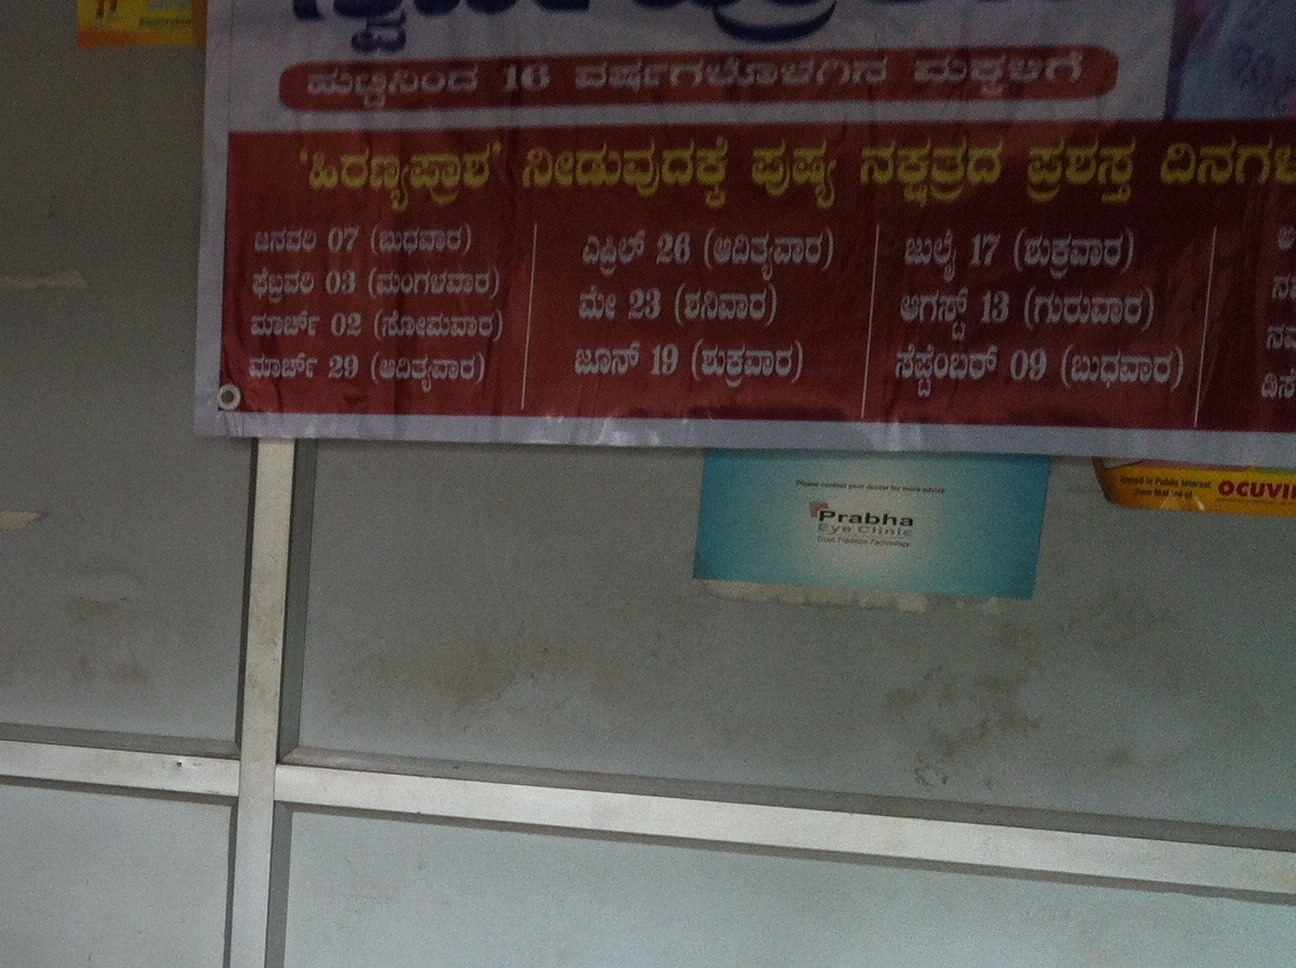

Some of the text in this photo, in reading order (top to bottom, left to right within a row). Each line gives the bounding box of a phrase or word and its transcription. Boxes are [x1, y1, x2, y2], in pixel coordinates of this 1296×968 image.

[502, 63, 552, 92] 16
[751, 137, 836, 208] ಪುಷ್ಯ
[860, 136, 1003, 207] ನಕ್ಷತ್ರದ
[1027, 136, 1136, 203] ಪ್ರಶಸ್ತ
[327, 225, 360, 253] 07
[656, 231, 691, 265] 26
[969, 232, 1001, 268] 17
[325, 269, 357, 295] 03
[628, 287, 662, 320] 23
[674, 282, 778, 327] (ಶನಿವಾರ)
[980, 290, 1010, 324] 13
[330, 312, 362, 337] 02
[328, 354, 359, 379] 29
[574, 340, 640, 376] ಜೂನ್
[650, 342, 679, 376] 19
[1009, 348, 1047, 381] 09
[818, 522, 913, 537] Eye Clinic
[819, 509, 913, 527] Prabha
